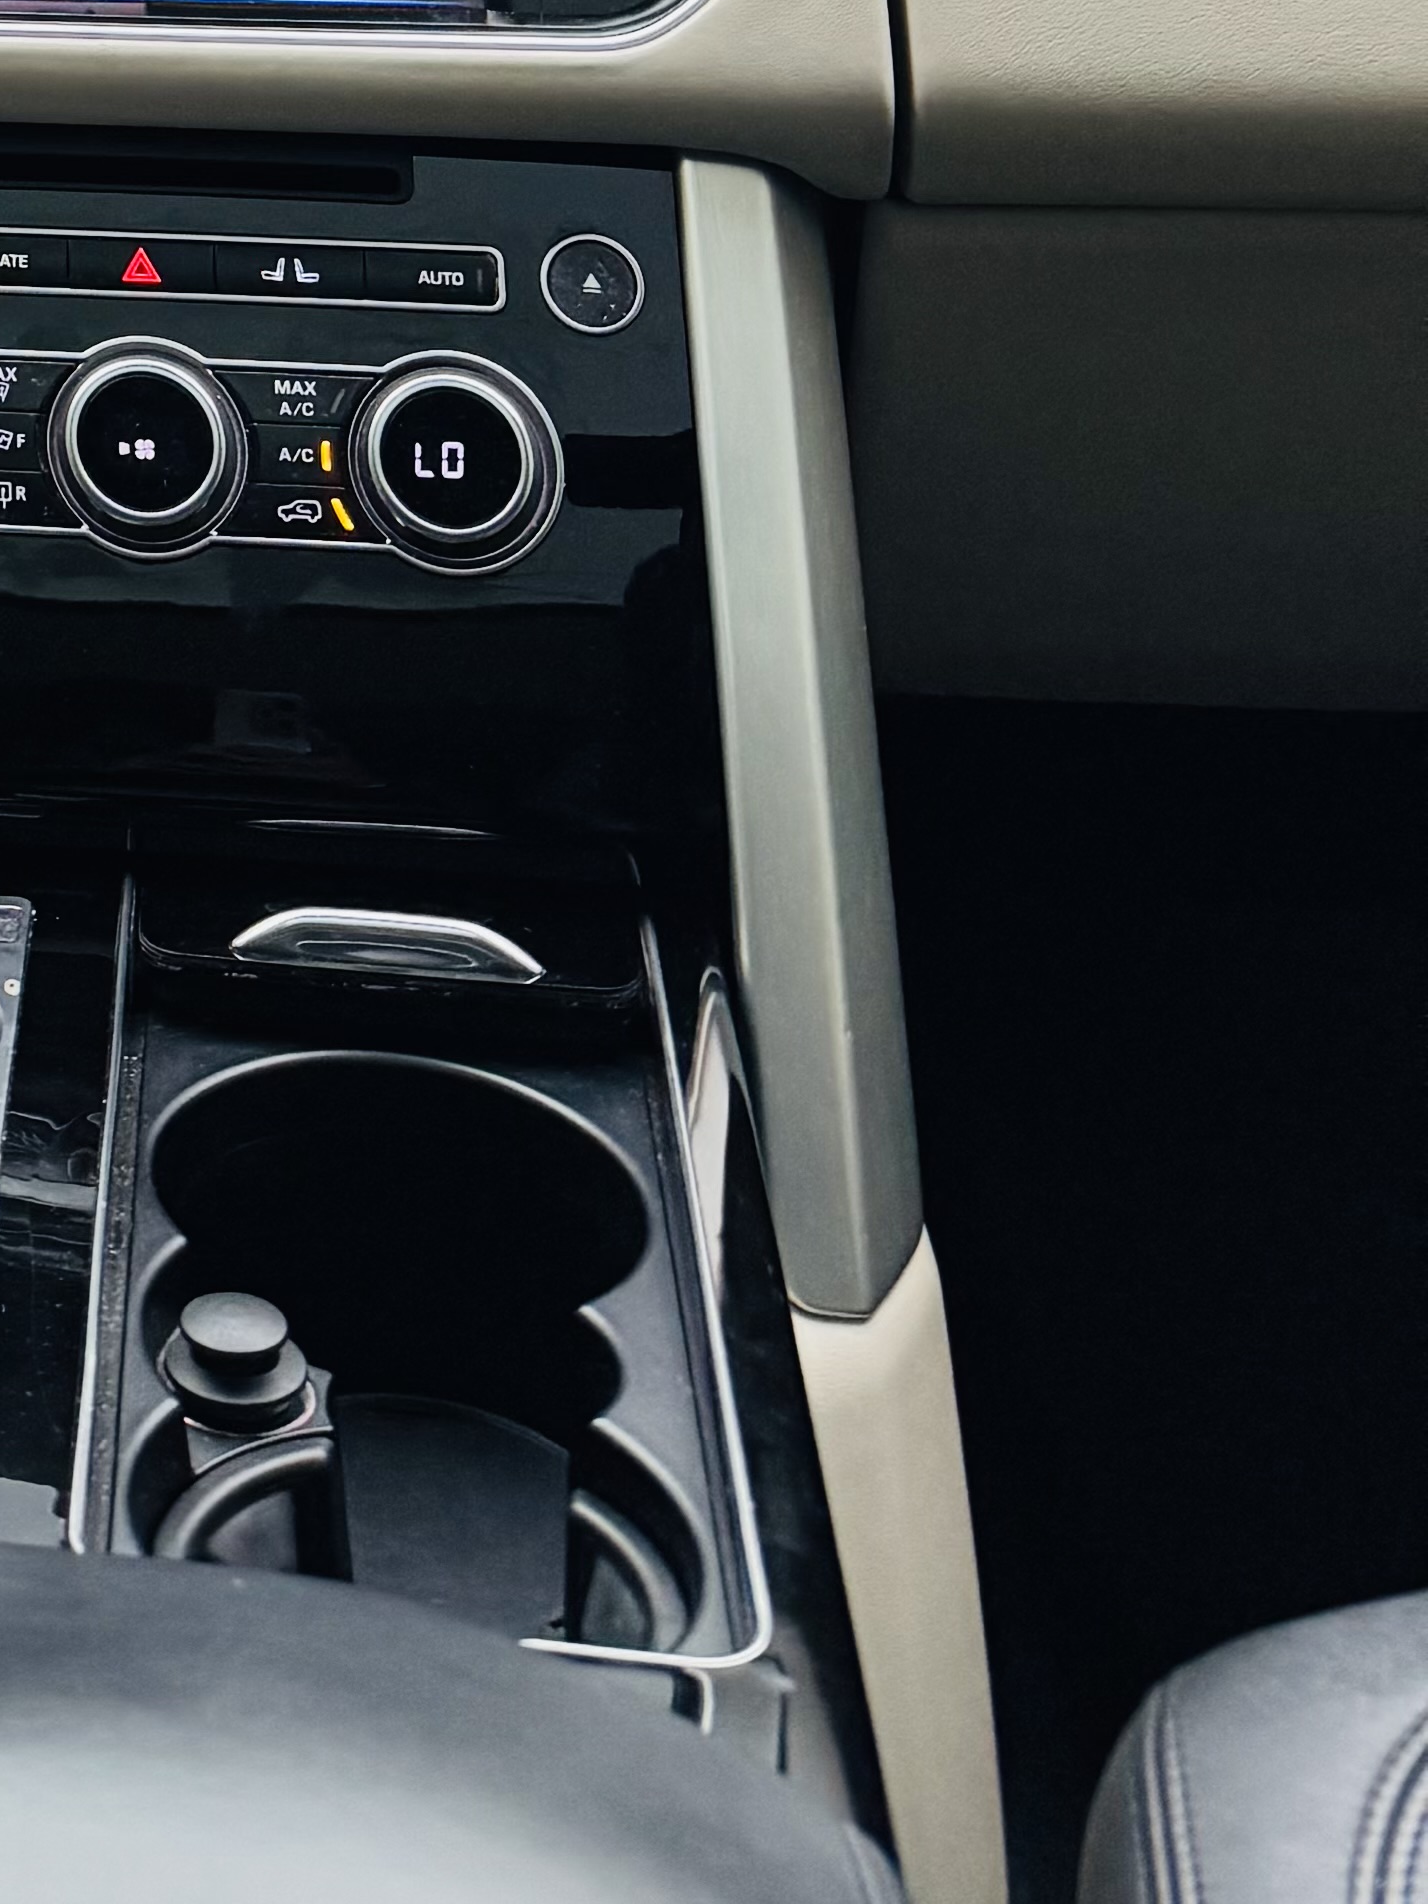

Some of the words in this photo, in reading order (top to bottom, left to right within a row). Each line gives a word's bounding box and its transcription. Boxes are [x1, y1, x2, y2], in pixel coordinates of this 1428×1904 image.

[418, 270, 465, 286] AUTO
[274, 379, 317, 396] MAX
[279, 402, 315, 417] A/C
[16, 433, 27, 448] F
[279, 447, 314, 464] A/C
[414, 441, 465, 480] LO
[15, 485, 27, 502] R
